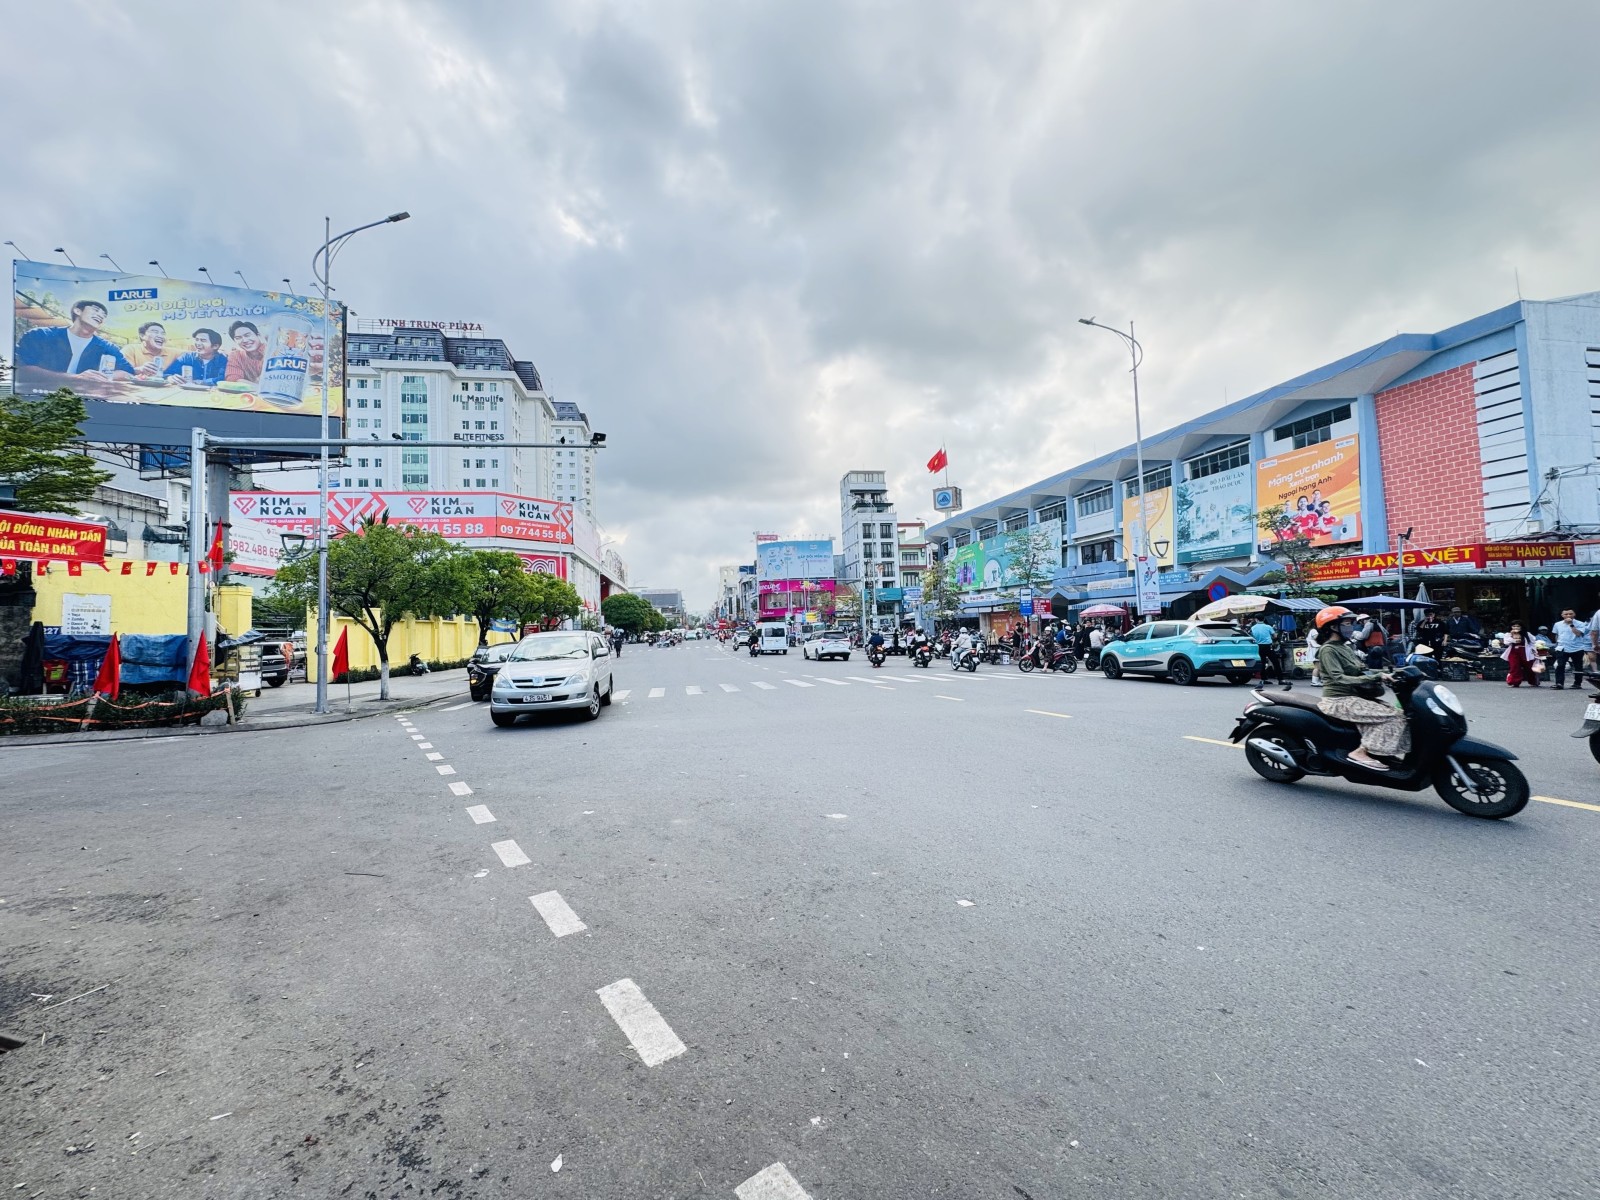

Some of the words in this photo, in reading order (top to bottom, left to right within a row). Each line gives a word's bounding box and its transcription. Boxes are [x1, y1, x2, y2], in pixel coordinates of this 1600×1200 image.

[114, 291, 152, 300] LARUE
[410, 320, 446, 329] TRUNG
[449, 322, 482, 331] PLAZA
[267, 359, 307, 370] LARUE
[467, 394, 504, 403] Manulife
[475, 433, 504, 441] FITNESS
[1311, 451, 1344, 471] nhanh
[1318, 475, 1333, 486] Anh
[260, 497, 290, 506] KIM
[431, 497, 459, 506] KIM
[519, 502, 540, 511] KIM
[260, 506, 307, 516] NGAN
[431, 506, 475, 515] NGAN
[520, 510, 550, 521] NGAN
[443, 523, 461, 535] 55
[465, 523, 484, 535] 88
[500, 525, 514, 534] 09
[514, 526, 527, 536] 77
[528, 528, 540, 537] 44
[542, 530, 554, 539] 55
[19, 540, 50, 554] TOÀN
[1516, 545, 1547, 557] HÀNG
[1549, 543, 1572, 558] VIỆT
[1358, 554, 1416, 569] HÀNG
[1422, 547, 1475, 564] VIỆT
